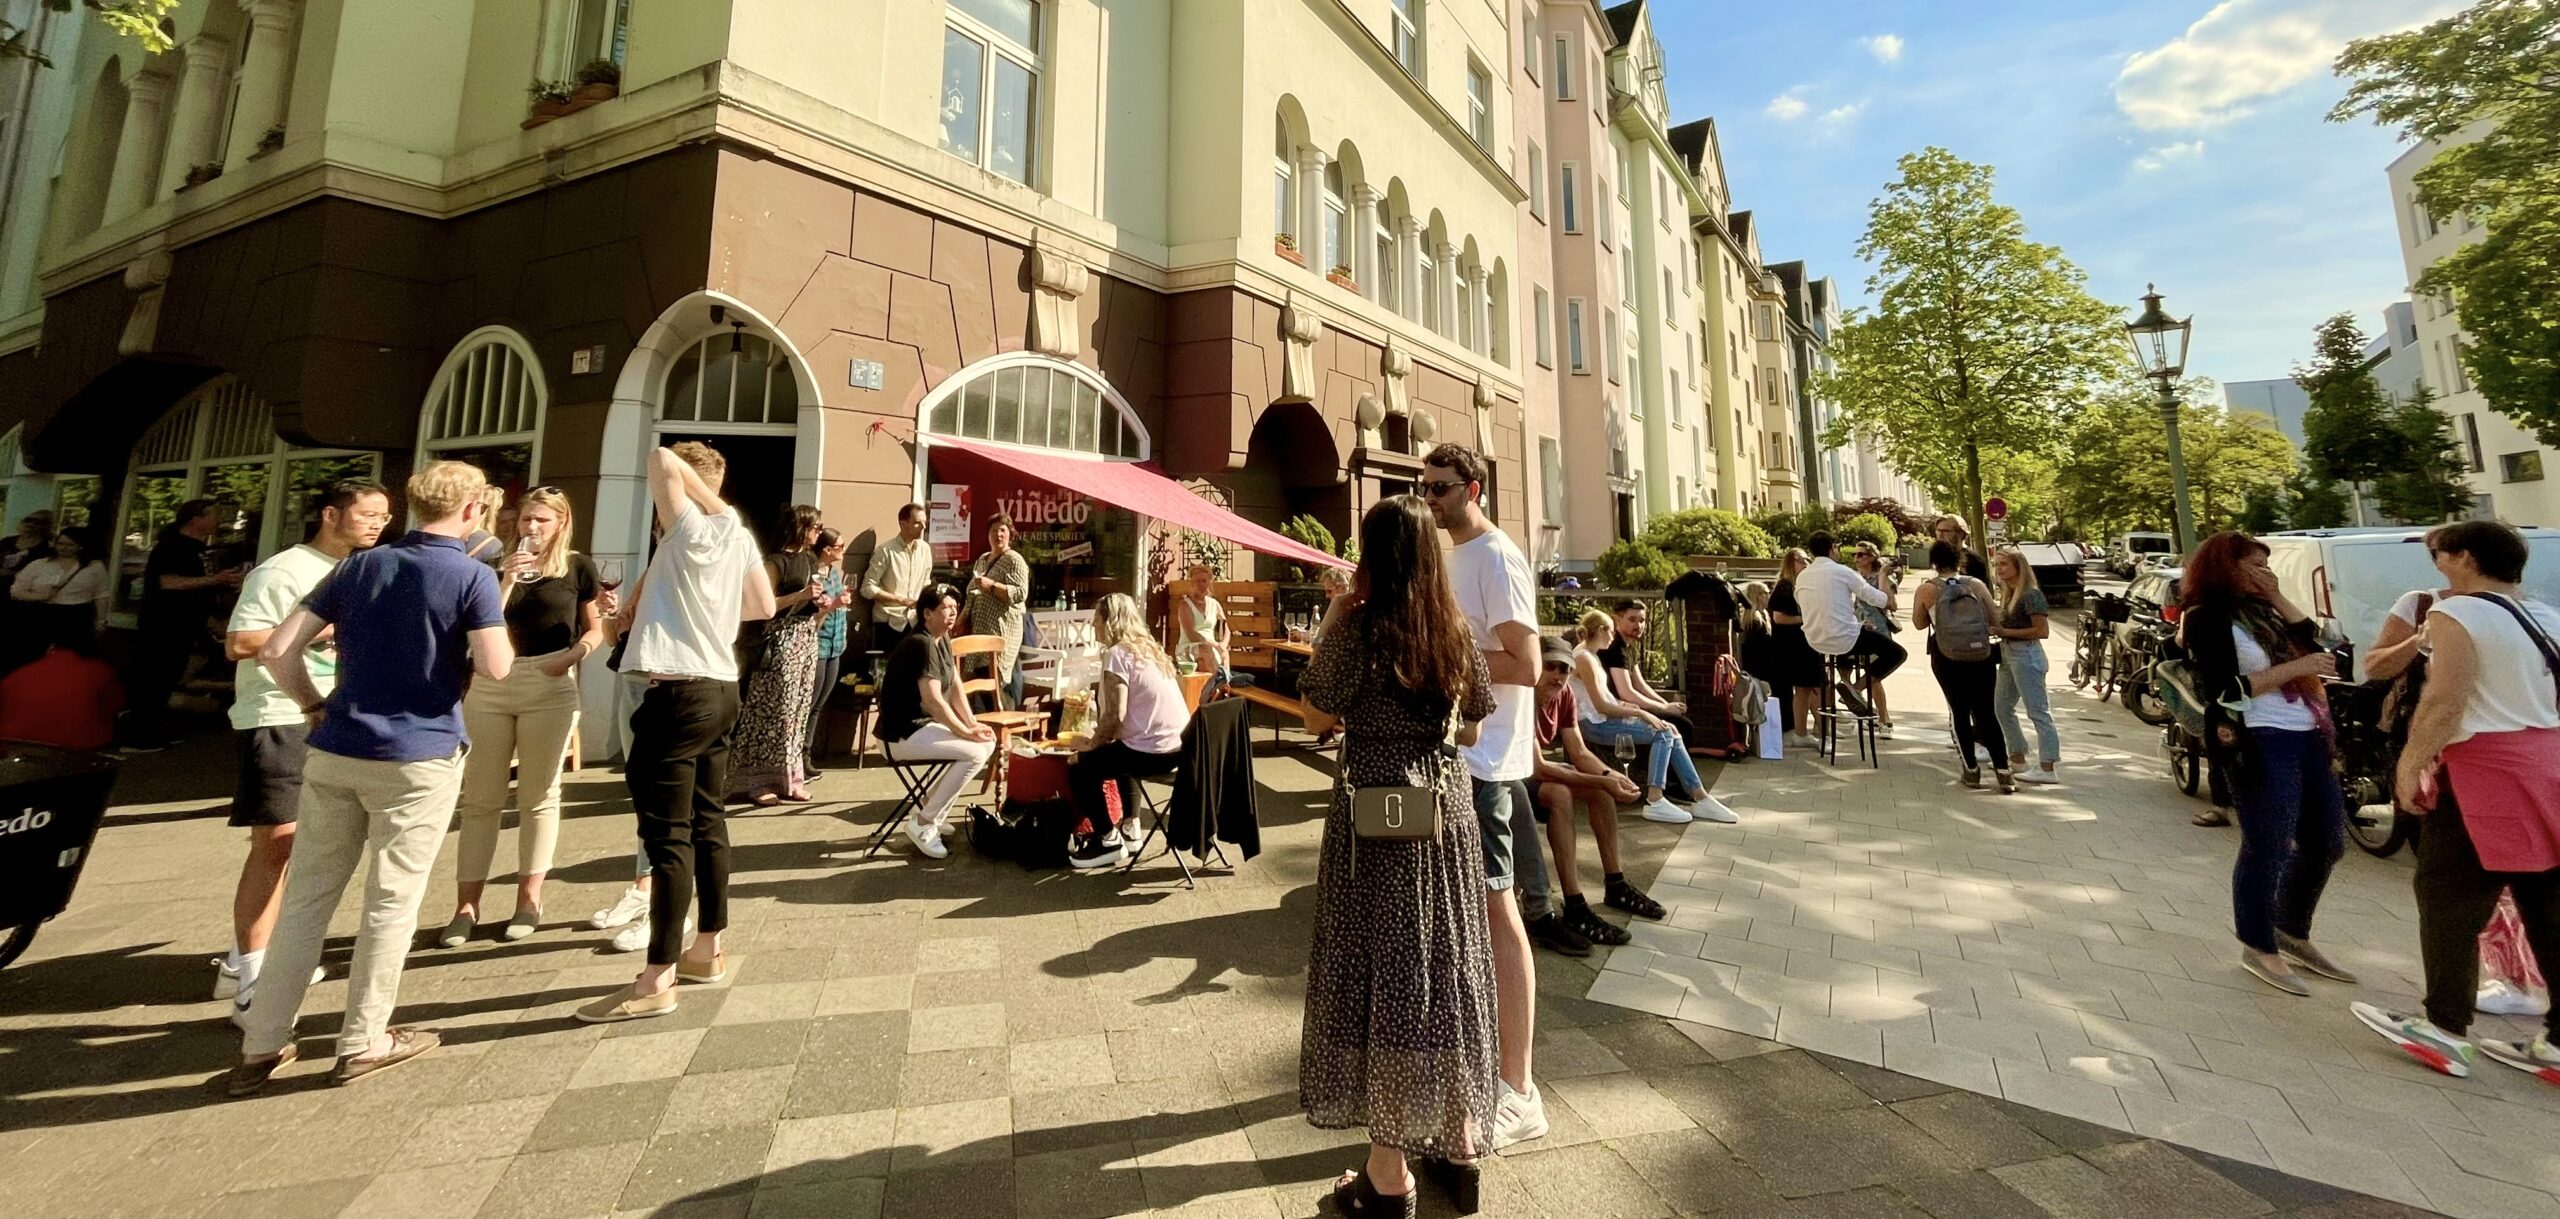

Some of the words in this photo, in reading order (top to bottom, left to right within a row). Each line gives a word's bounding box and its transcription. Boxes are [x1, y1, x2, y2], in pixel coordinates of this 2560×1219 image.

[997, 489, 1089, 524] viñedo
[1030, 532, 1048, 541] AUS
[1049, 532, 1087, 541] SPANIEN
